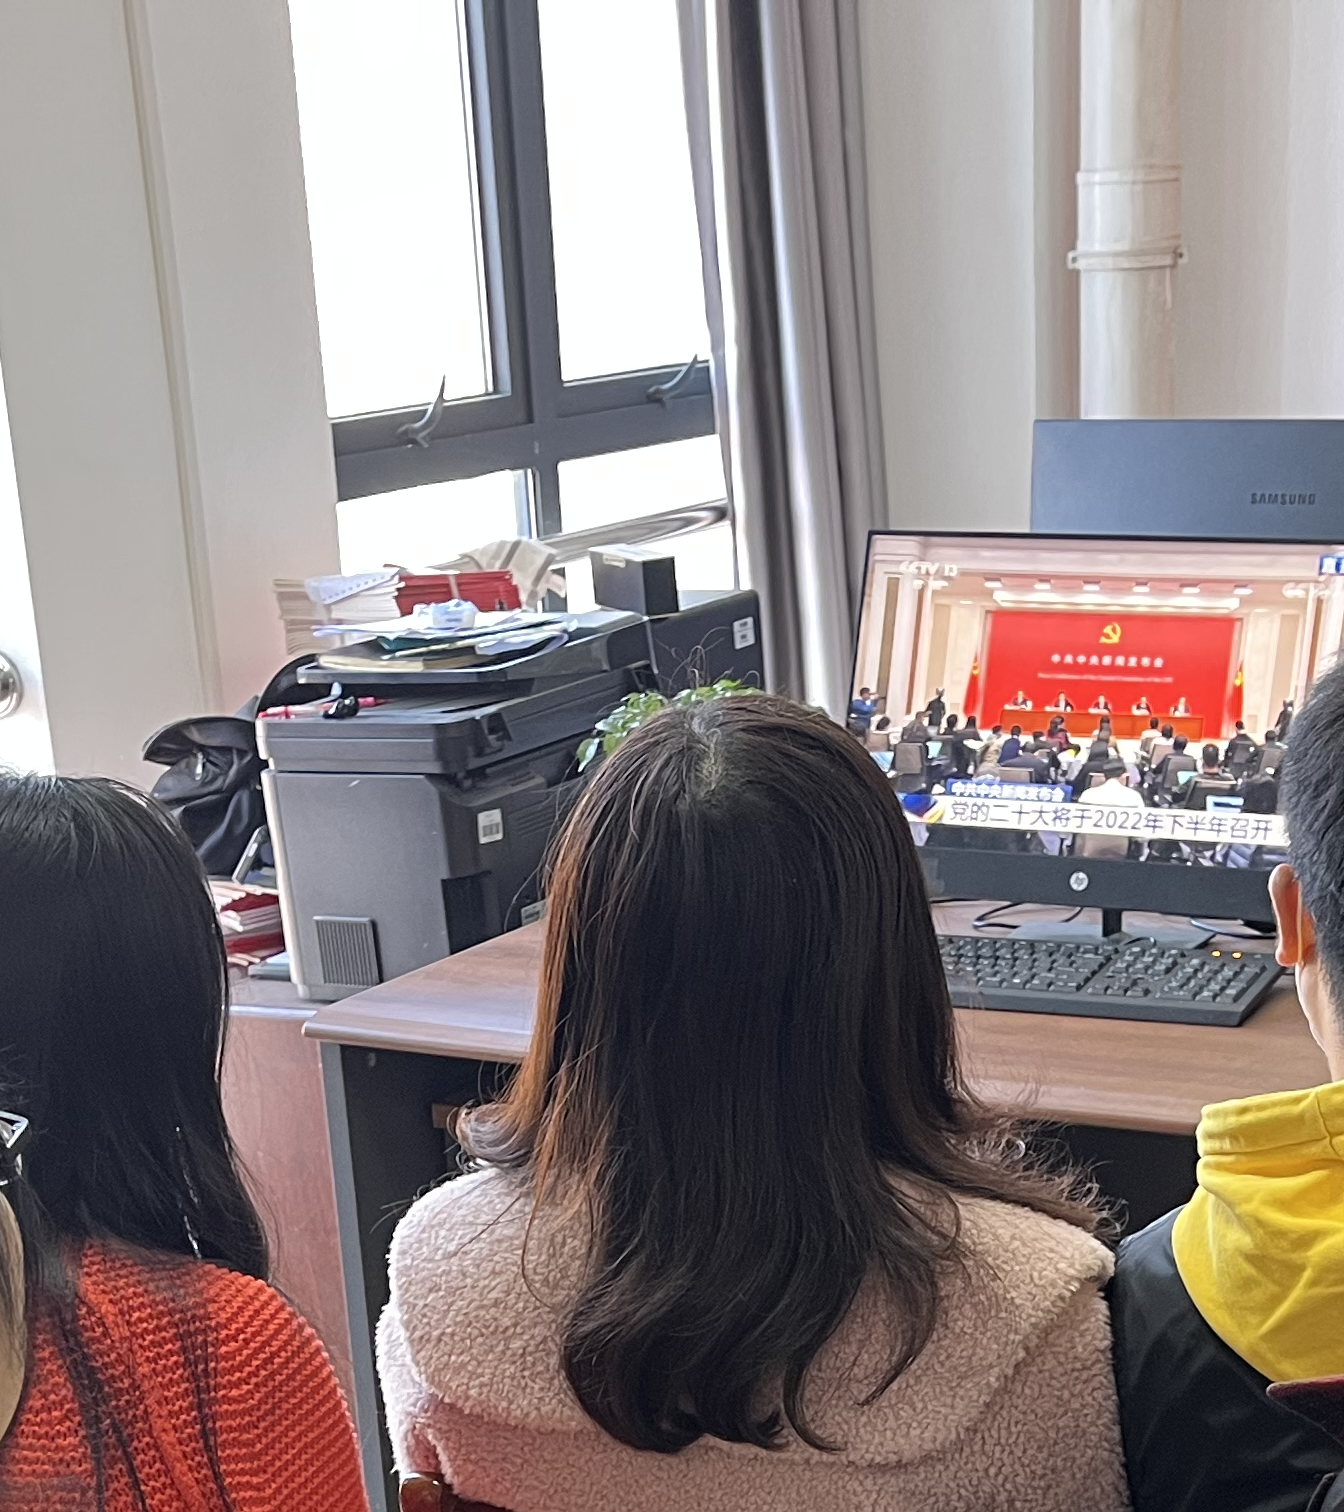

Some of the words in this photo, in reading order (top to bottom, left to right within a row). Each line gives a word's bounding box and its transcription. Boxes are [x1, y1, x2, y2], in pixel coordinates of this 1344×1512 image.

[1250, 492, 1316, 506] SAMSUNG
[951, 781, 1066, 803] 中共中央新闻发布会
[949, 799, 1274, 841] 党的二十大将于2022年下半年召开
